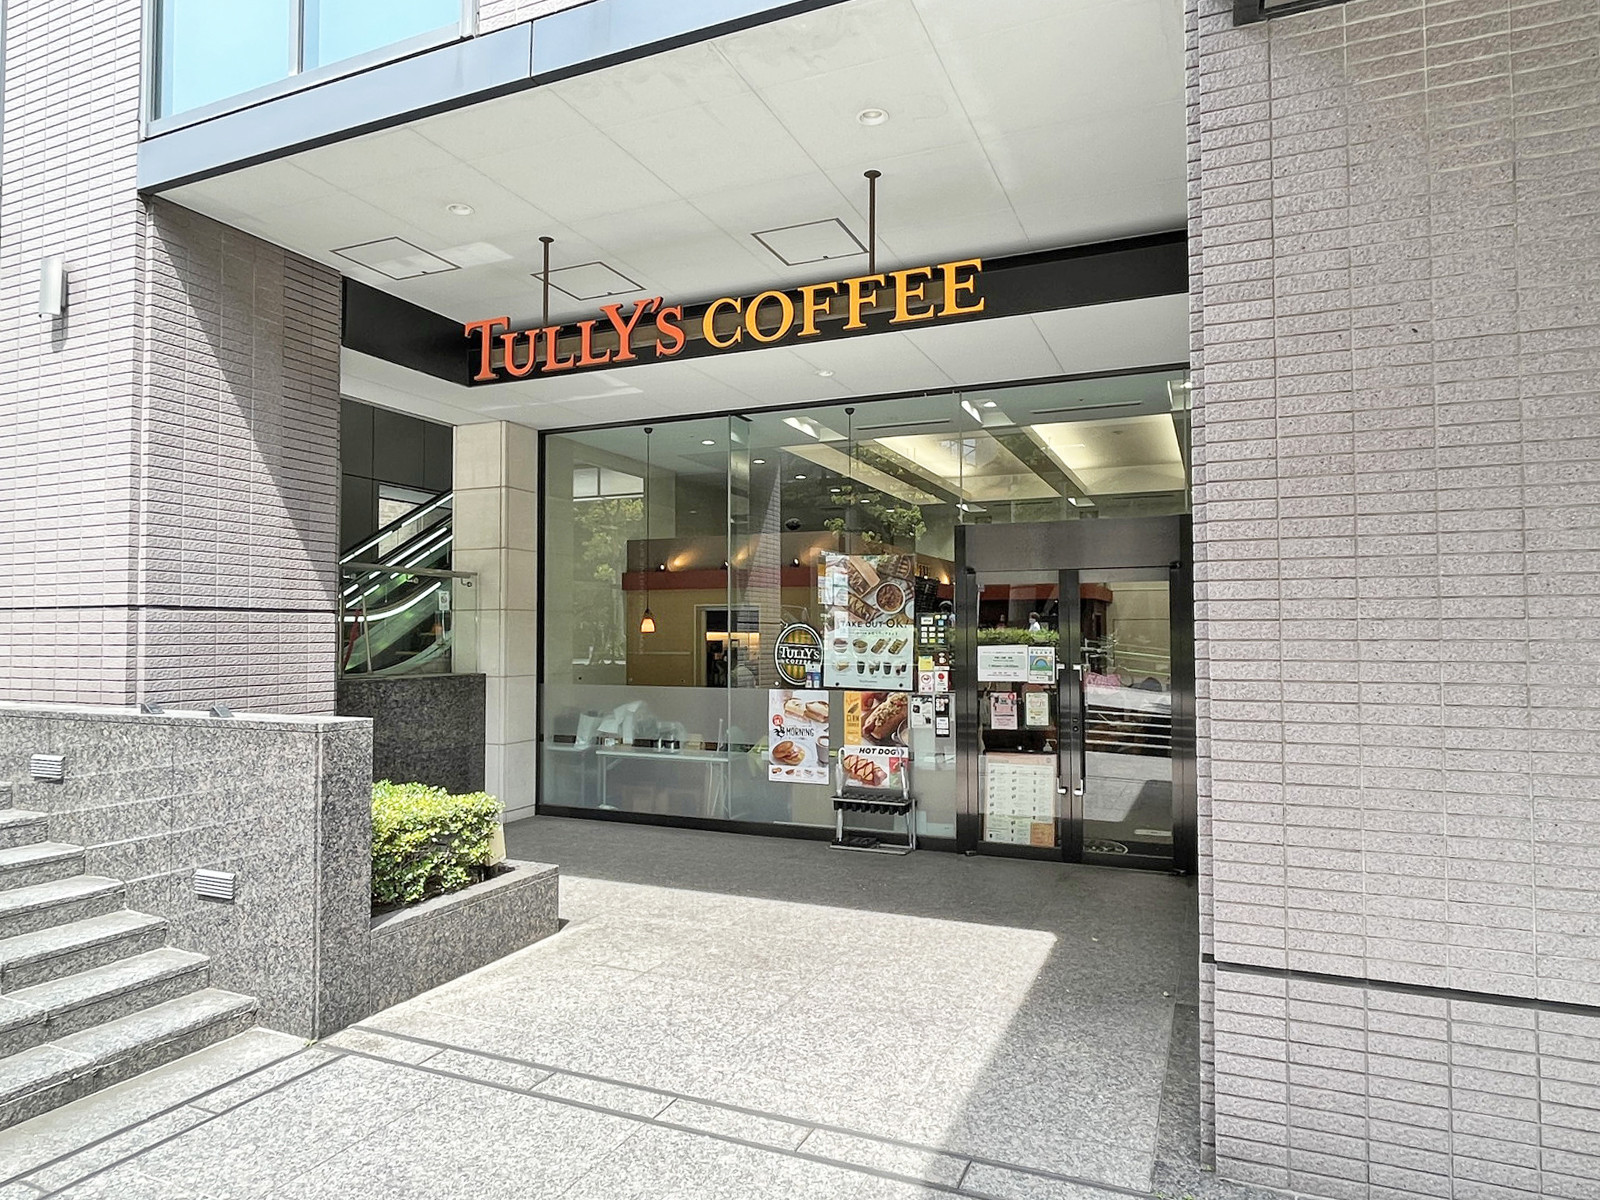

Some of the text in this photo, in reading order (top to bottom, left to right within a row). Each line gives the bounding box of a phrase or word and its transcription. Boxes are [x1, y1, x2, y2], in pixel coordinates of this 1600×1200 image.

[702, 257, 986, 349] COFFEE
[841, 618, 908, 628] TAKE OUT OK!
[786, 727, 815, 737] MORNING
